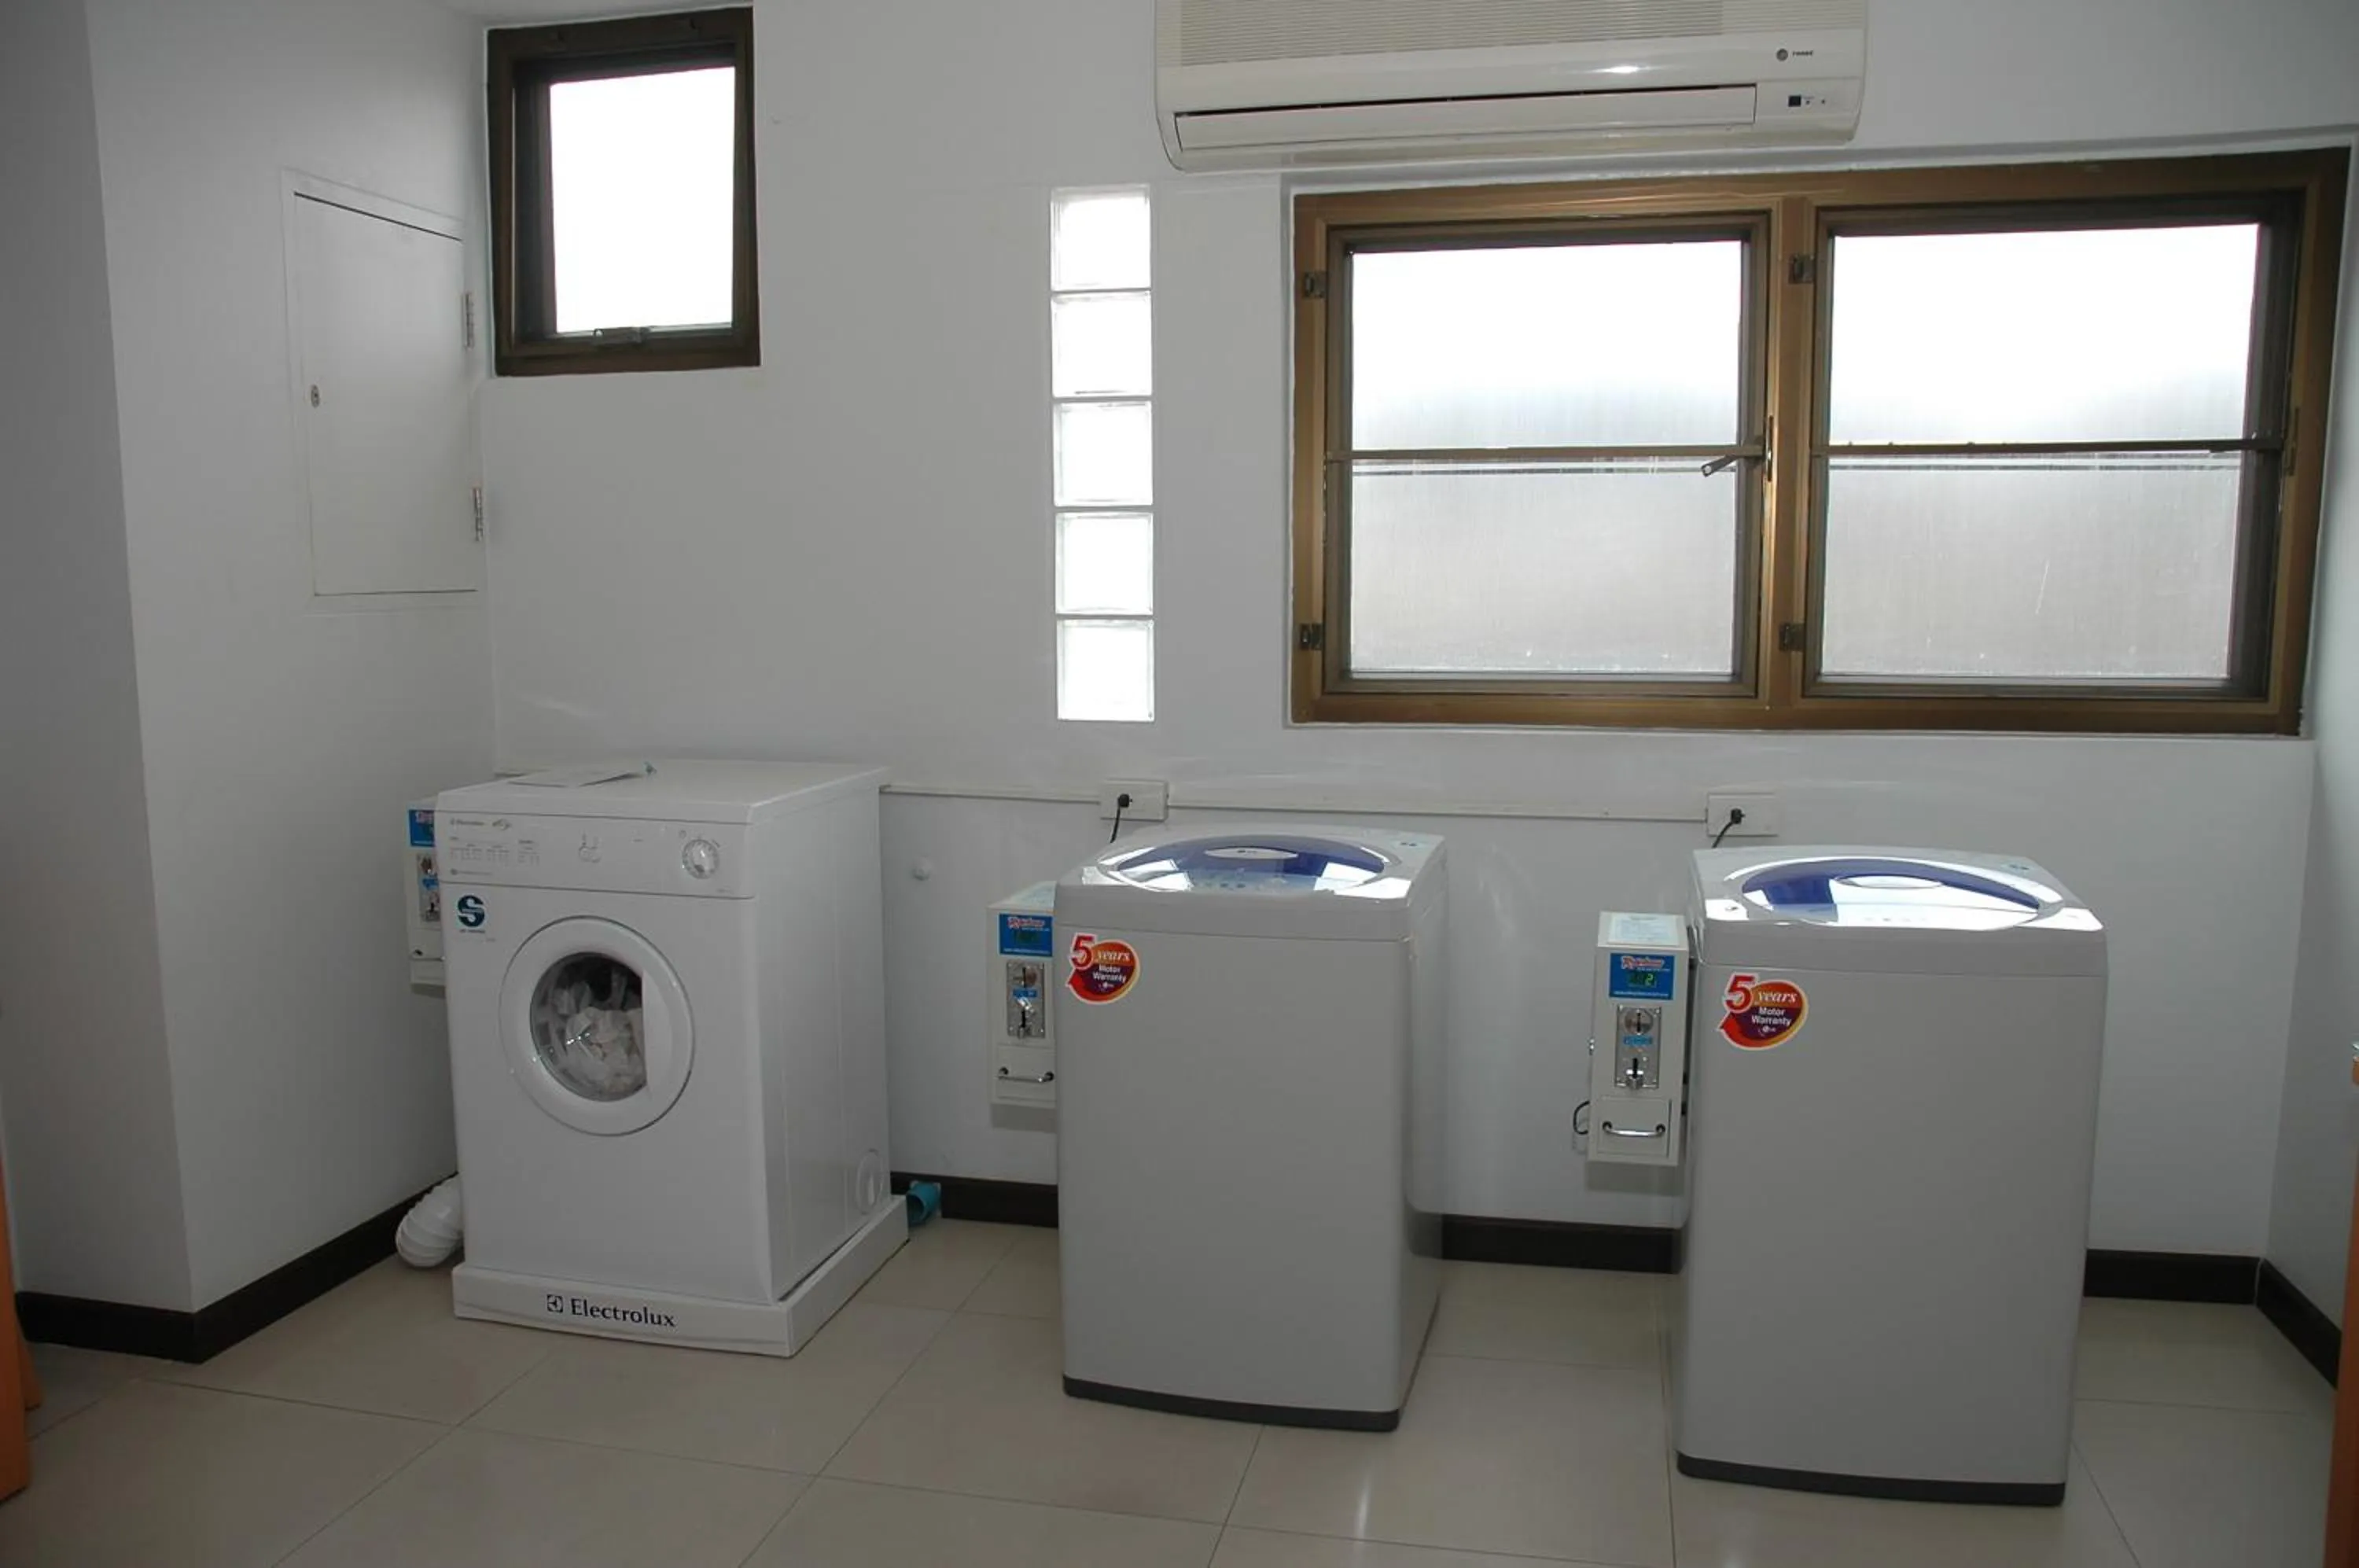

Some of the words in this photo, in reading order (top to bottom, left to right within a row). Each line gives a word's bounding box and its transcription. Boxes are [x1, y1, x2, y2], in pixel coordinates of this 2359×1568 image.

[1071, 933, 1095, 969] 5
[1724, 974, 1754, 1012] 5
[1758, 992, 1798, 1004] years
[1751, 1015, 1791, 1026] Warranty
[1759, 1007, 1785, 1016] Motor
[571, 1297, 676, 1327] Electrolux
